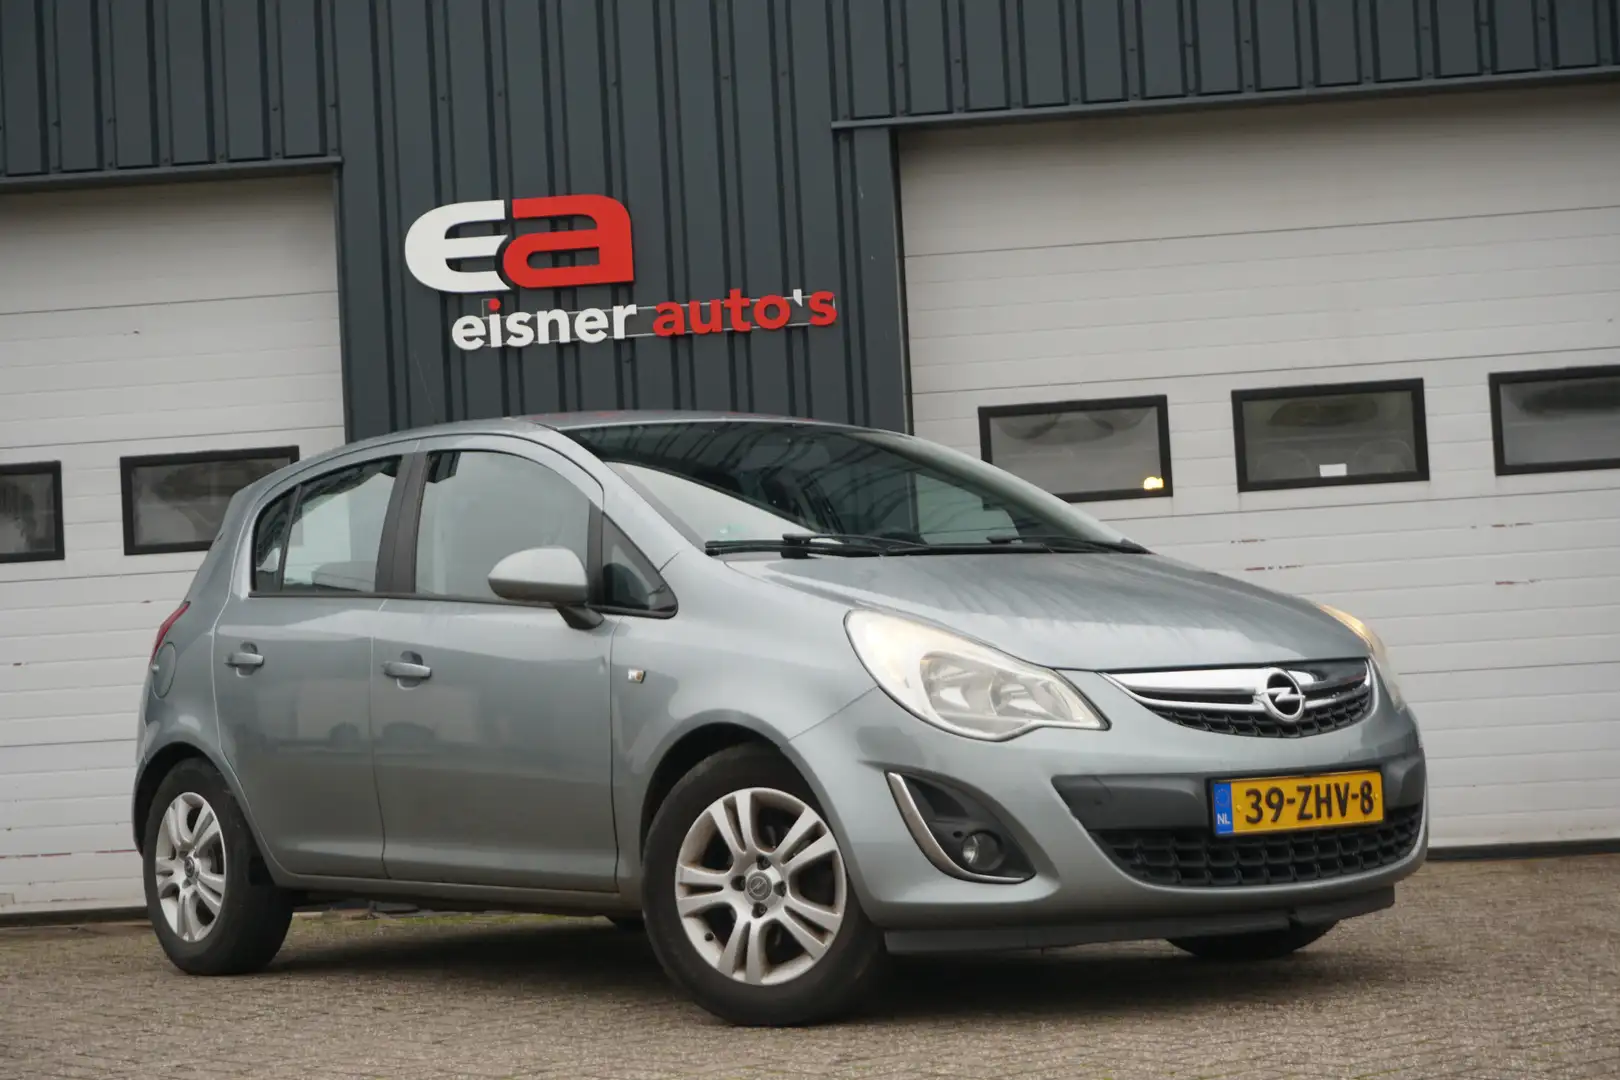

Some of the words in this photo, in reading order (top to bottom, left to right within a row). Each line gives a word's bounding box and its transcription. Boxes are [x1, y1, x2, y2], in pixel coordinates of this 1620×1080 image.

[405, 194, 634, 292] ea
[452, 299, 637, 350] eisner
[653, 288, 837, 337] auto's
[1217, 813, 1231, 825] NL
[1245, 780, 1374, 824] 39-ZHV-8
